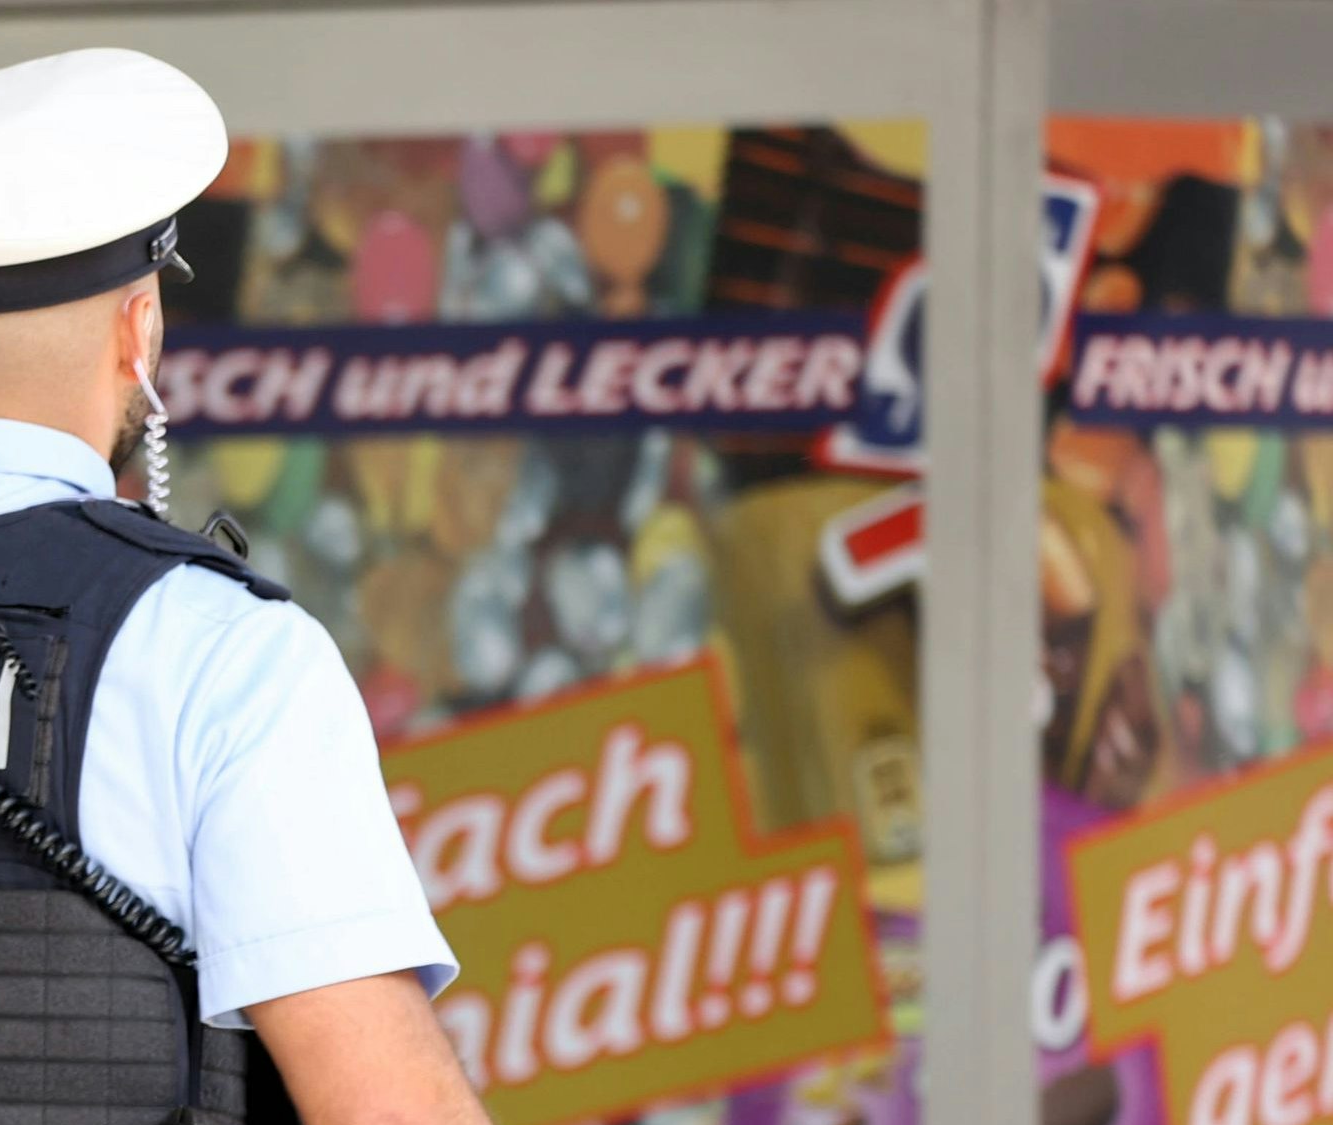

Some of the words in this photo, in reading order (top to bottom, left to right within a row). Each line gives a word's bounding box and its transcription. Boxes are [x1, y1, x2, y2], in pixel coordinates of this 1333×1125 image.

[331, 338, 528, 421] und
[525, 334, 863, 417] LECKER
[1072, 333, 1292, 413] FRISCH
[1111, 783, 1333, 1003] Einf
